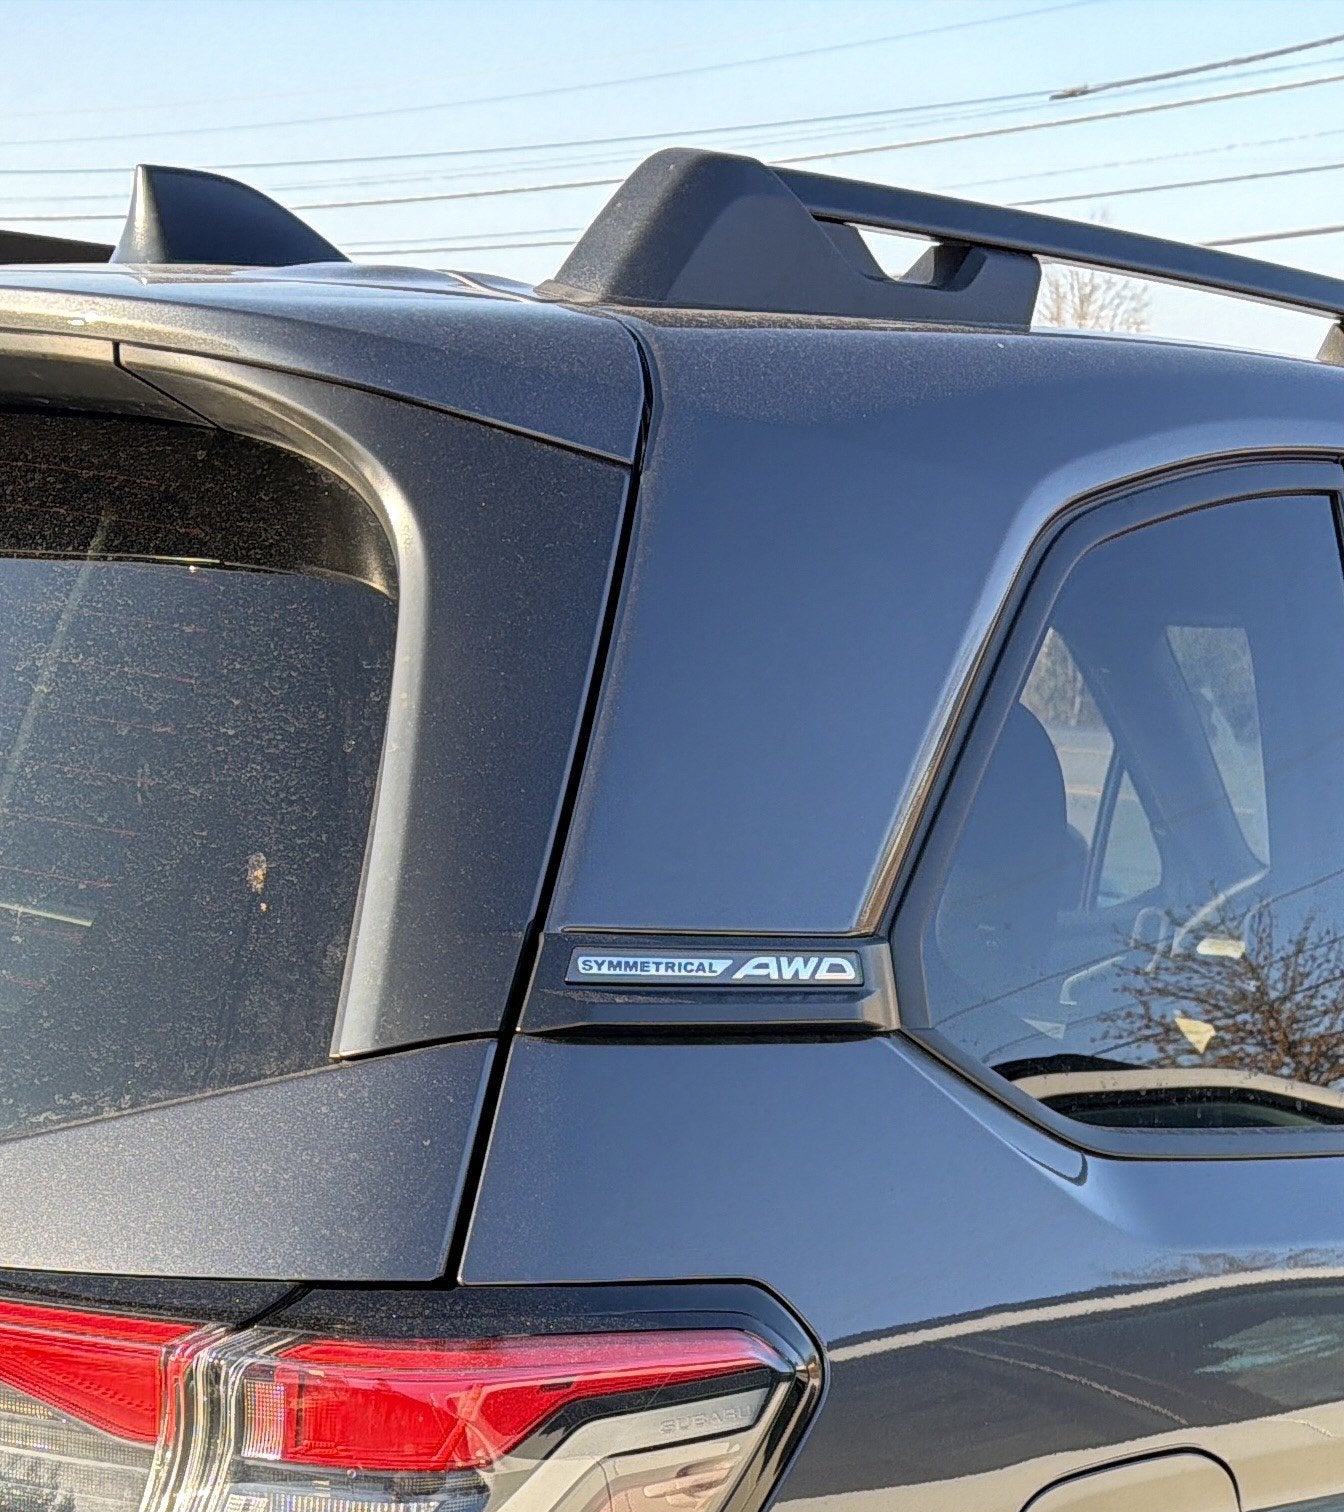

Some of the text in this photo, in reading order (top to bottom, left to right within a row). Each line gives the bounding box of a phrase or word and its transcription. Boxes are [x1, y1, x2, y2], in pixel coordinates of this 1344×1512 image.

[580, 956, 857, 980] SYMMETRICAL AWD
[659, 1404, 752, 1435] SUBARU
